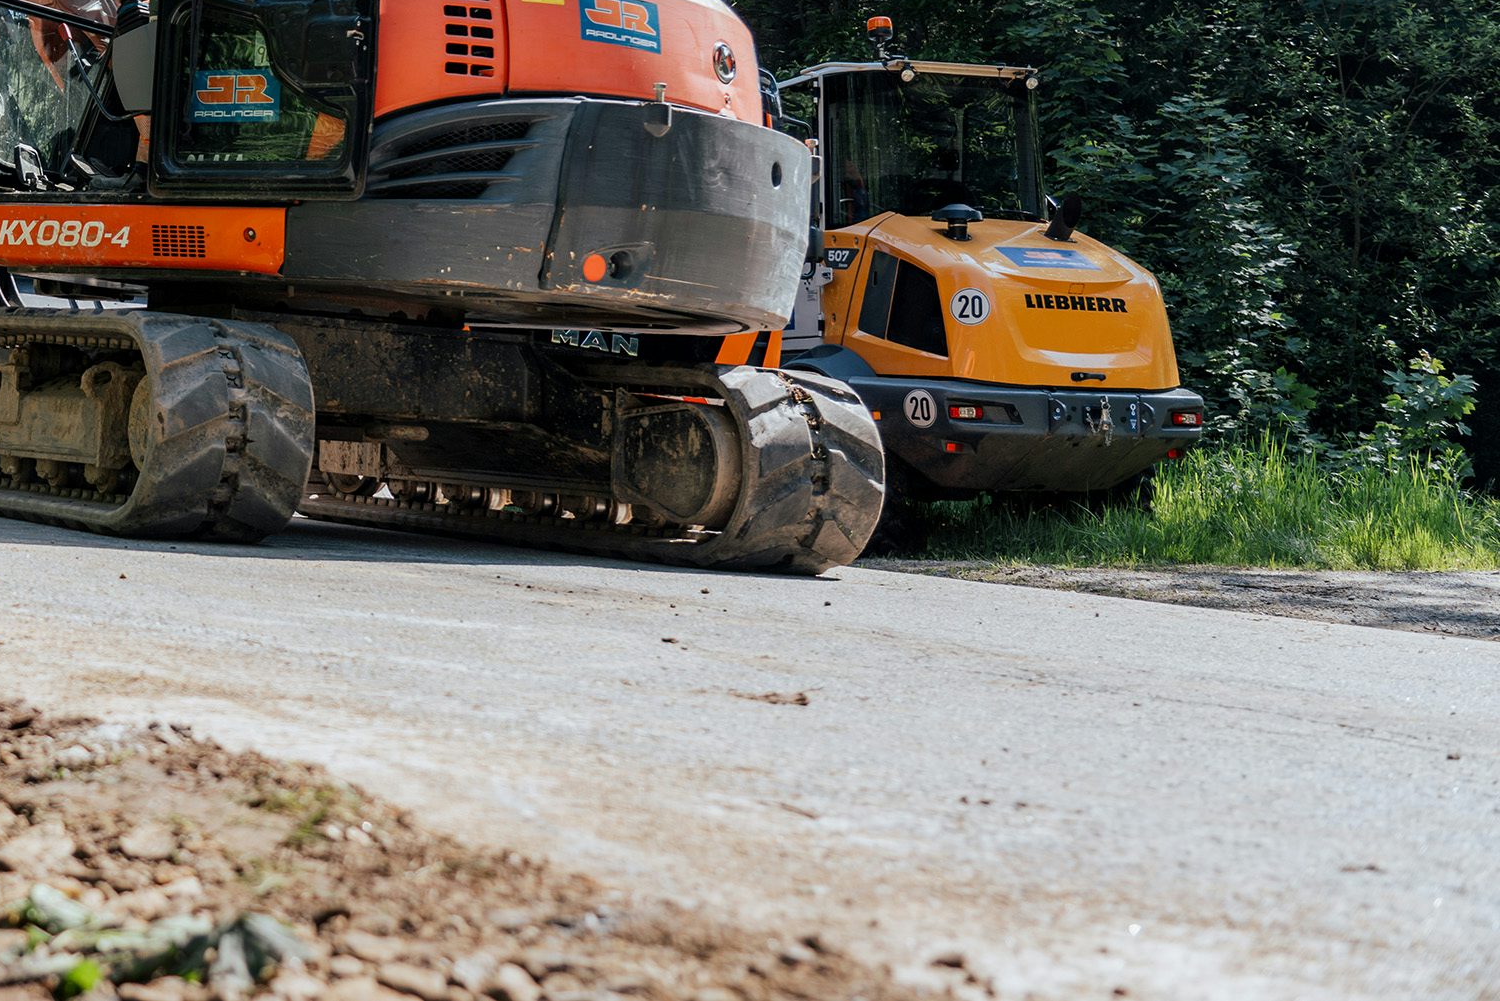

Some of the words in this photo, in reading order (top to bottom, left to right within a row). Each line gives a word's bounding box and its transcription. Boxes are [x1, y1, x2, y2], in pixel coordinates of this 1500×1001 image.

[828, 250, 849, 262] 507
[958, 294, 983, 319] 20
[1024, 293, 1128, 313] LIEBHERR
[551, 328, 639, 357] MAN
[909, 396, 931, 422] 20
